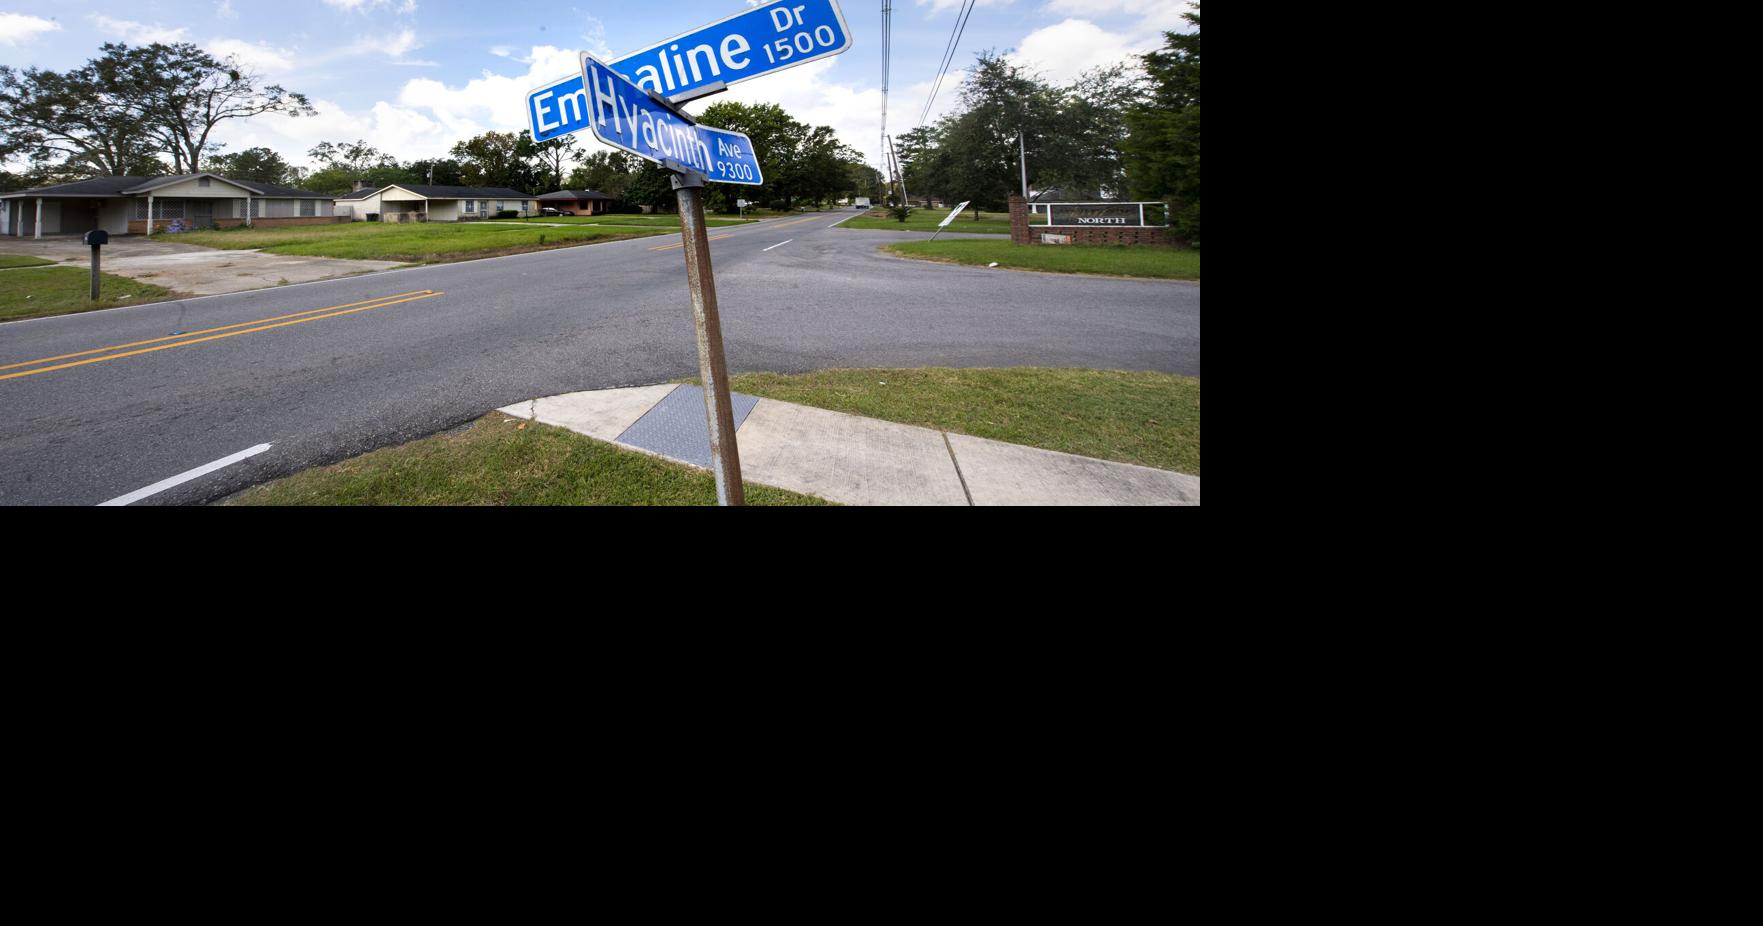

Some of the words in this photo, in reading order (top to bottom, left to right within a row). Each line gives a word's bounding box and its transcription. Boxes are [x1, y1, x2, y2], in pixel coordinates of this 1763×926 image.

[533, 33, 751, 133] Emaline
[769, 5, 806, 33] Dr
[762, 24, 836, 64] 1500
[590, 65, 714, 173] Hyacinth
[717, 138, 742, 159] Ave
[717, 161, 753, 181] 9300
